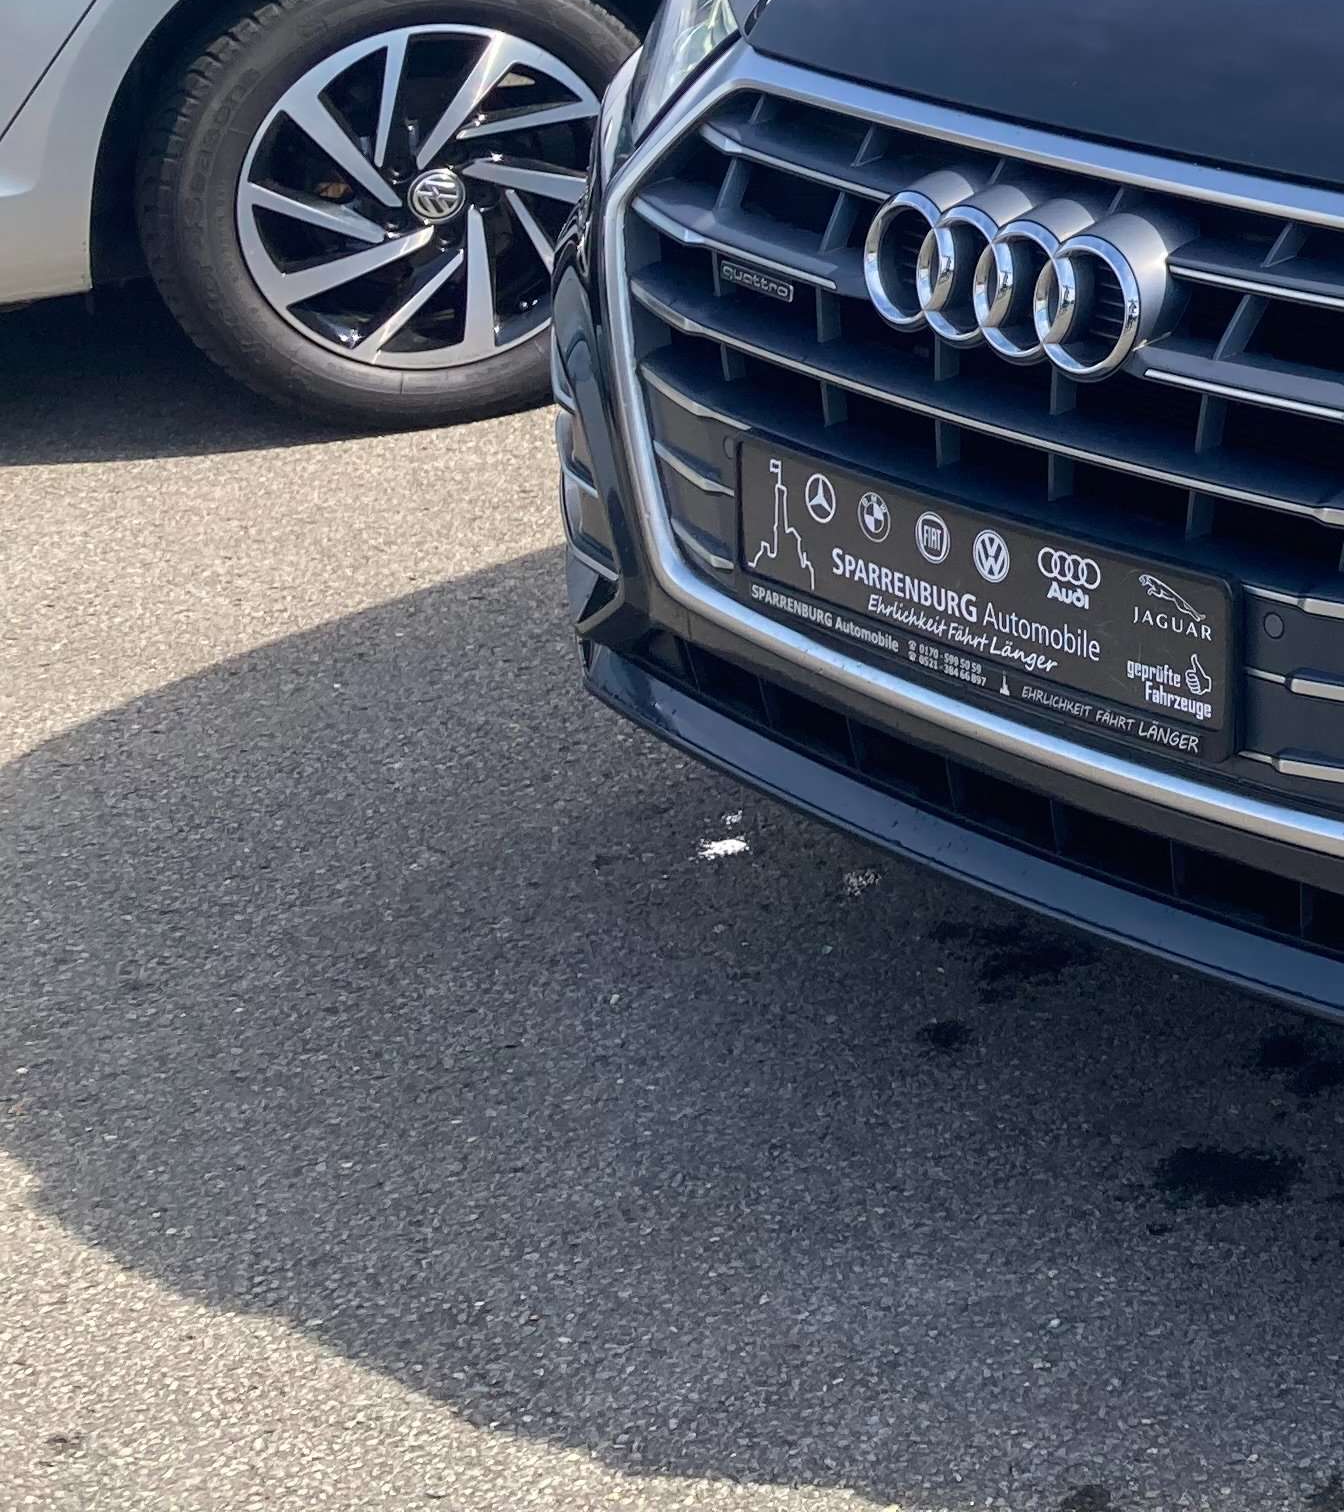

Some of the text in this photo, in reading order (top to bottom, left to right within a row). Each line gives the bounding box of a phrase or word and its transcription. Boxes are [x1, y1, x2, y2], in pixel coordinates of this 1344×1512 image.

[722, 265, 788, 297] quattro
[923, 525, 942, 550] FIAT
[831, 547, 1101, 662] SPARRENBURG Automobile
[1046, 582, 1090, 610] Audi
[751, 584, 900, 654] SPARRENBURG Automobile
[868, 594, 1059, 673] Ehrlichkeit Fährt Länger
[1132, 606, 1212, 641] JAGUAR
[919, 642, 939, 659] 0170
[1127, 659, 1181, 688] geprüfte
[1145, 682, 1212, 720] Fahrzeuge
[1021, 686, 1093, 719] EHRLICHKEIT
[1138, 721, 1200, 754] LÄNGER
